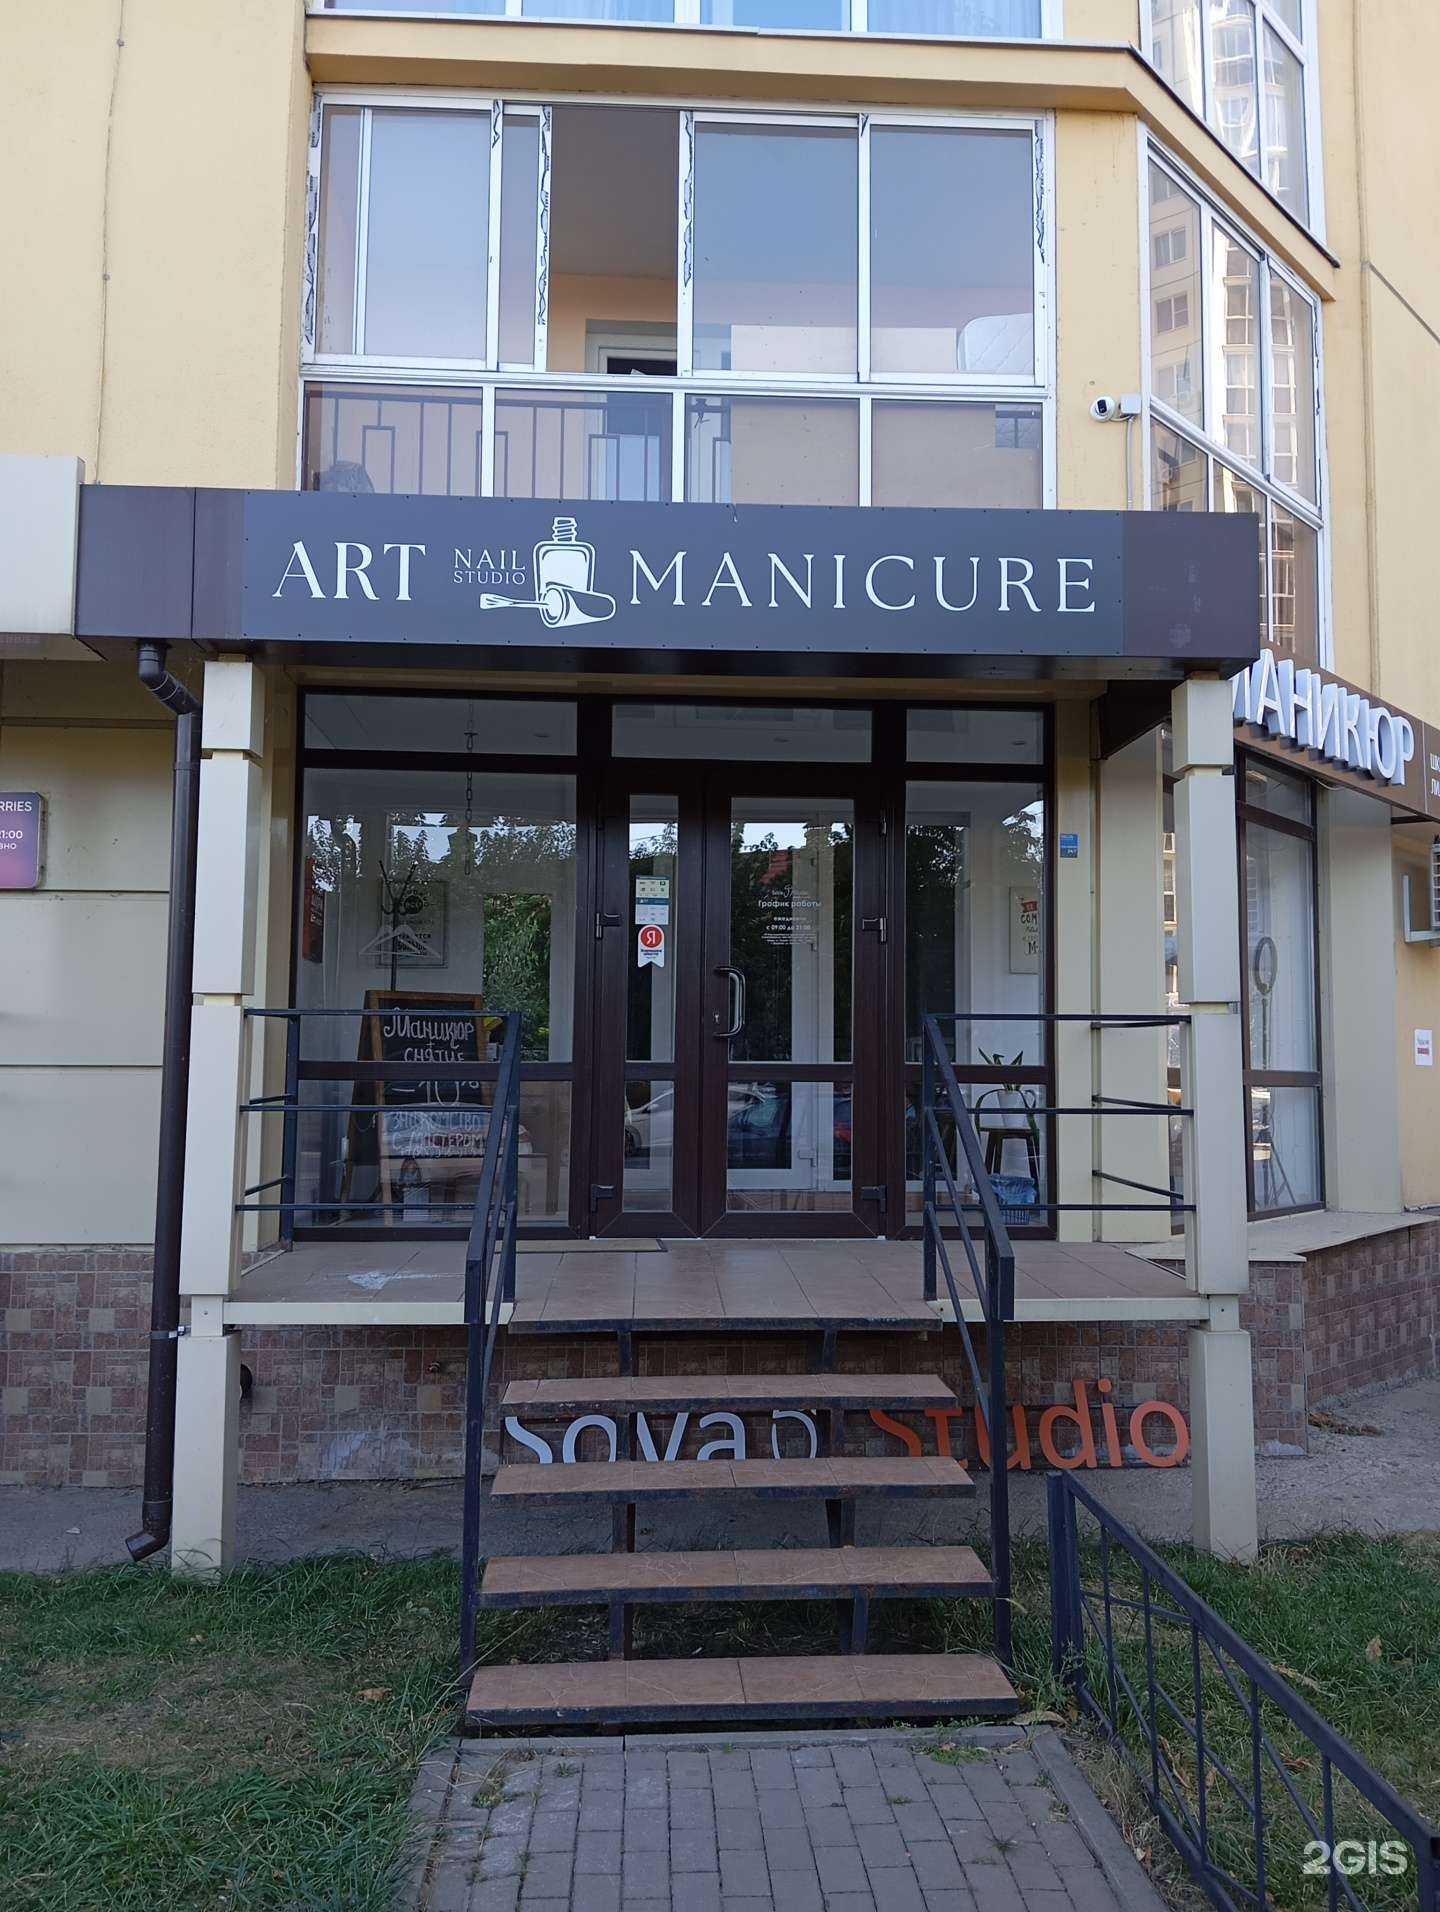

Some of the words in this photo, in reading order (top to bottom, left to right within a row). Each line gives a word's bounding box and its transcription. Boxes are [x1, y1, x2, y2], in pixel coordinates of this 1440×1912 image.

[454, 548, 527, 570] NAIL
[272, 540, 426, 601] ART
[453, 570, 527, 585] STUDIO
[629, 549, 1097, 614] MANICURE
[758, 899, 790, 908] График
[791, 899, 822, 908] работы
[646, 930, 656, 944] Я
